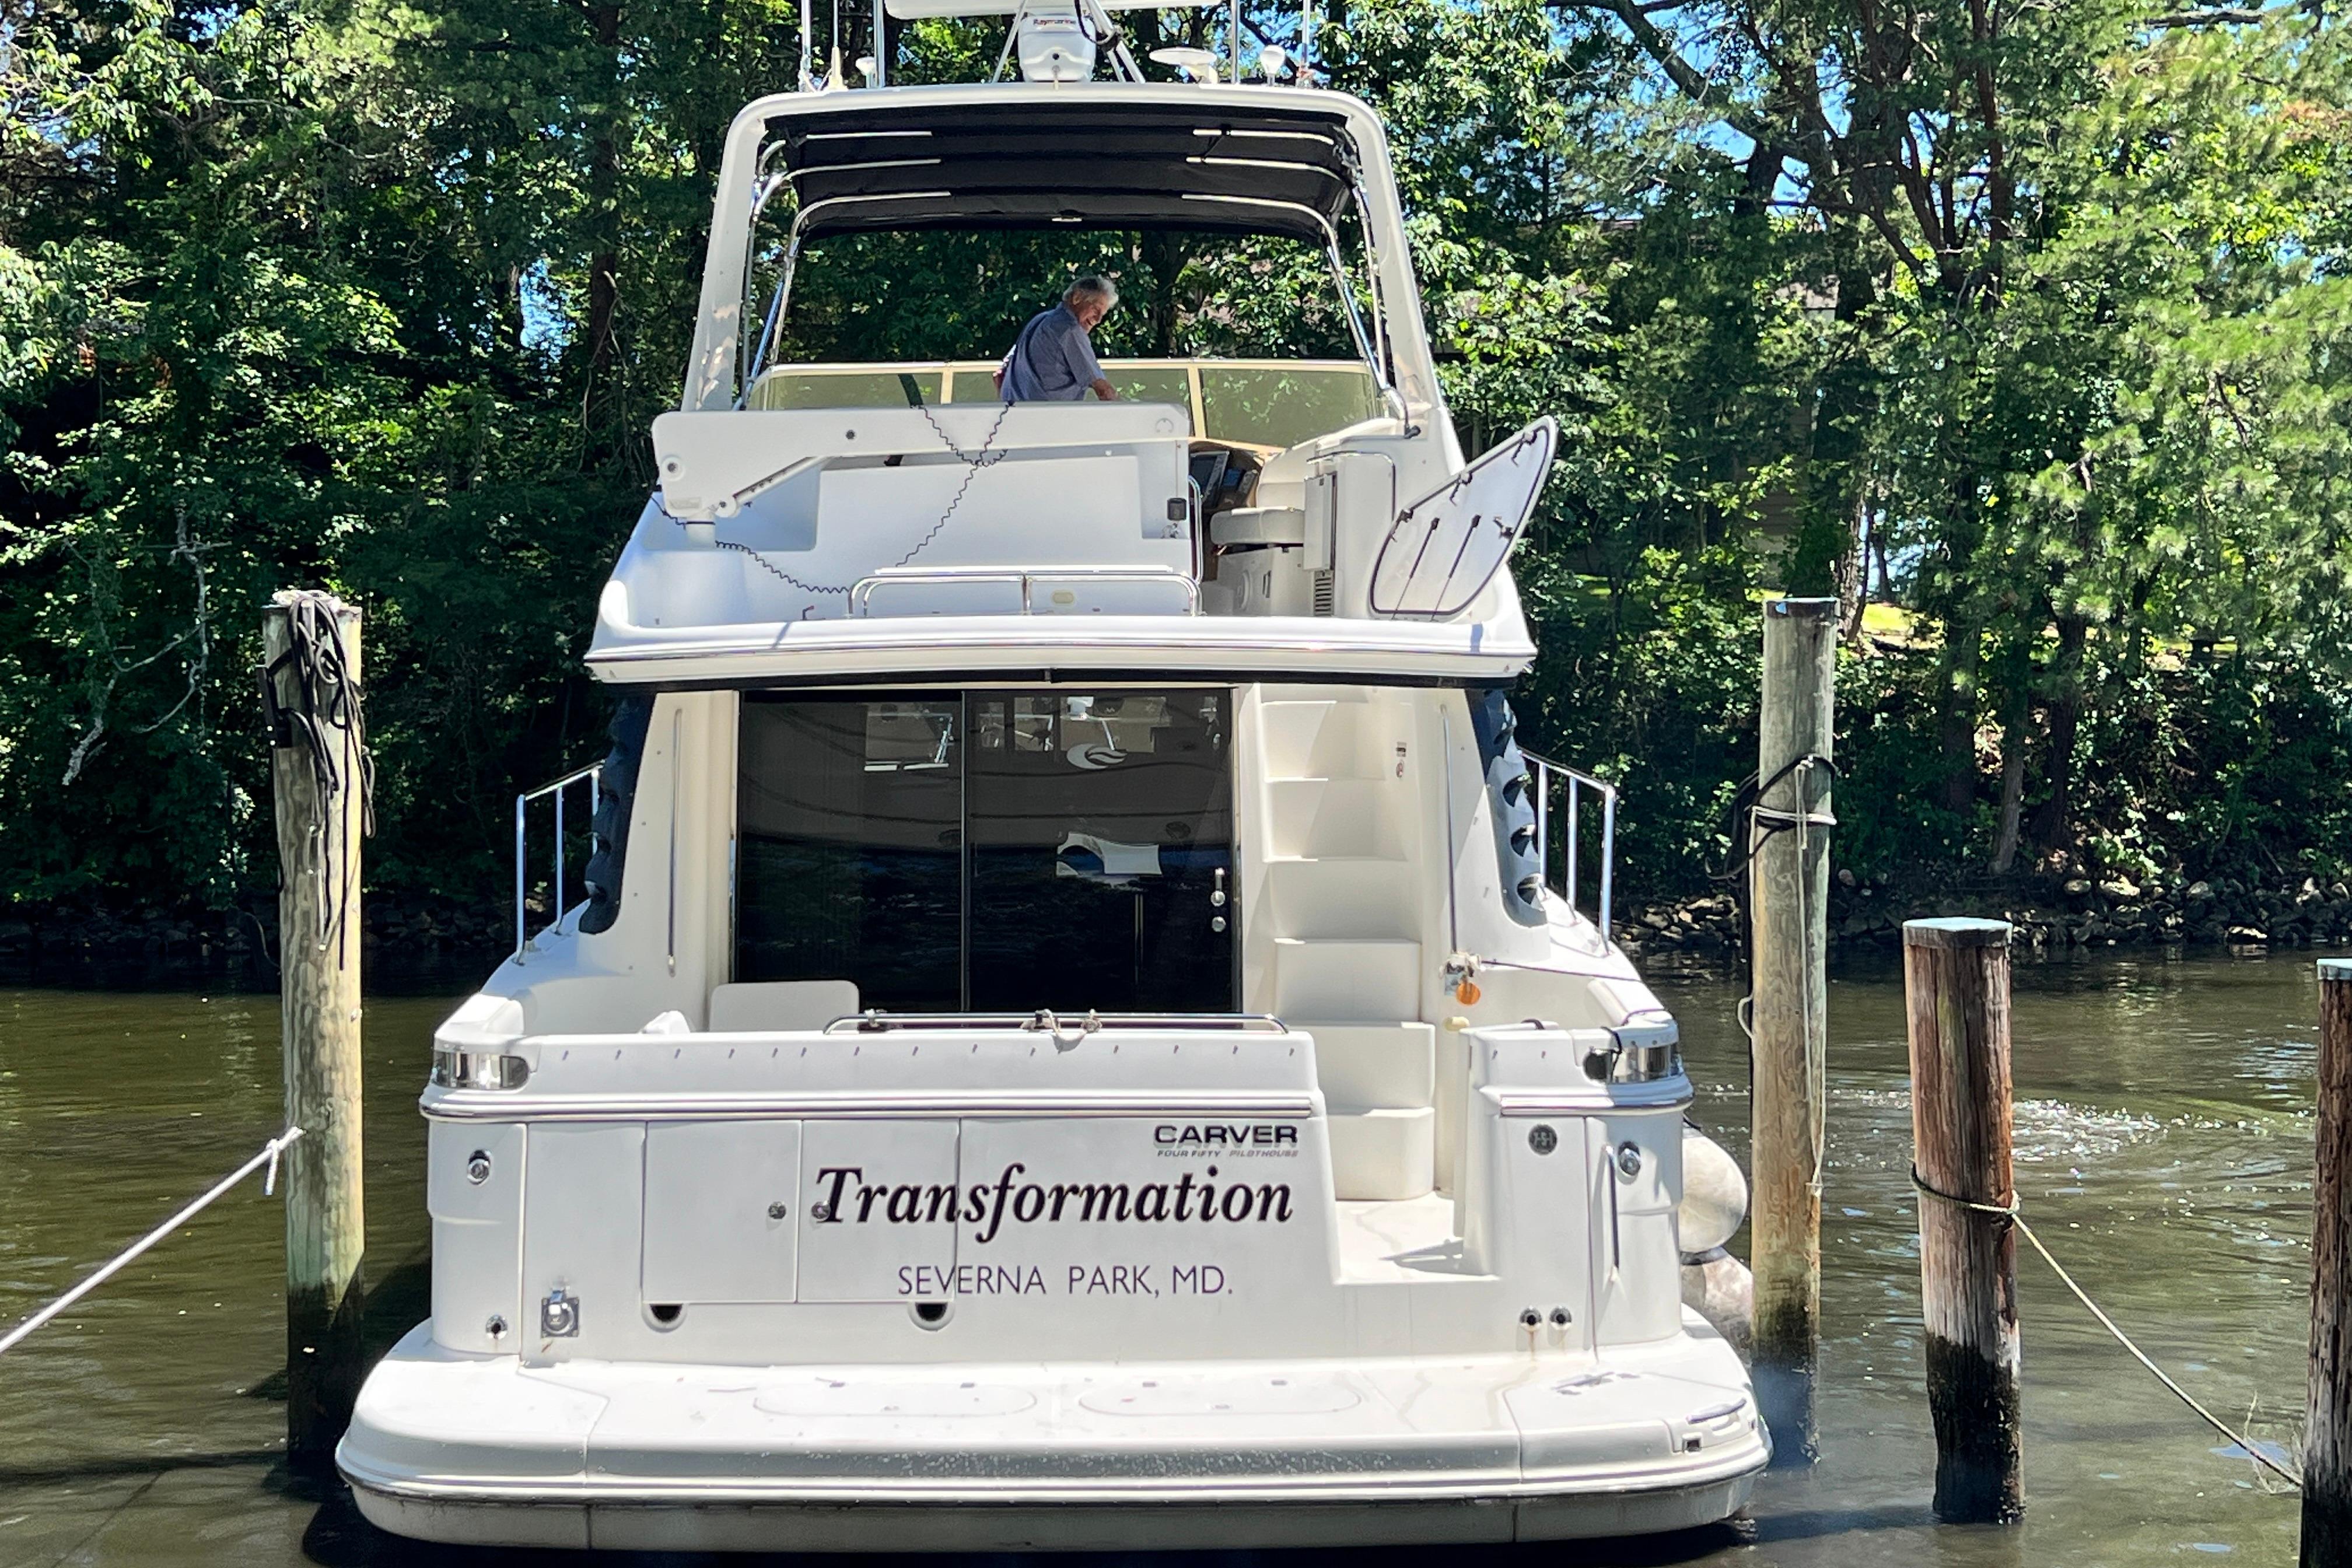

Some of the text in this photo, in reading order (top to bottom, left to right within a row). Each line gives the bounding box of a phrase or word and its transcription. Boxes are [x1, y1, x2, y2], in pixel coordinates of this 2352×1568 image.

[1154, 1125, 1298, 1143] CARVER
[816, 1163, 1293, 1244] Transformation
[898, 1265, 1233, 1297] SEVERNA PARK, MD.
